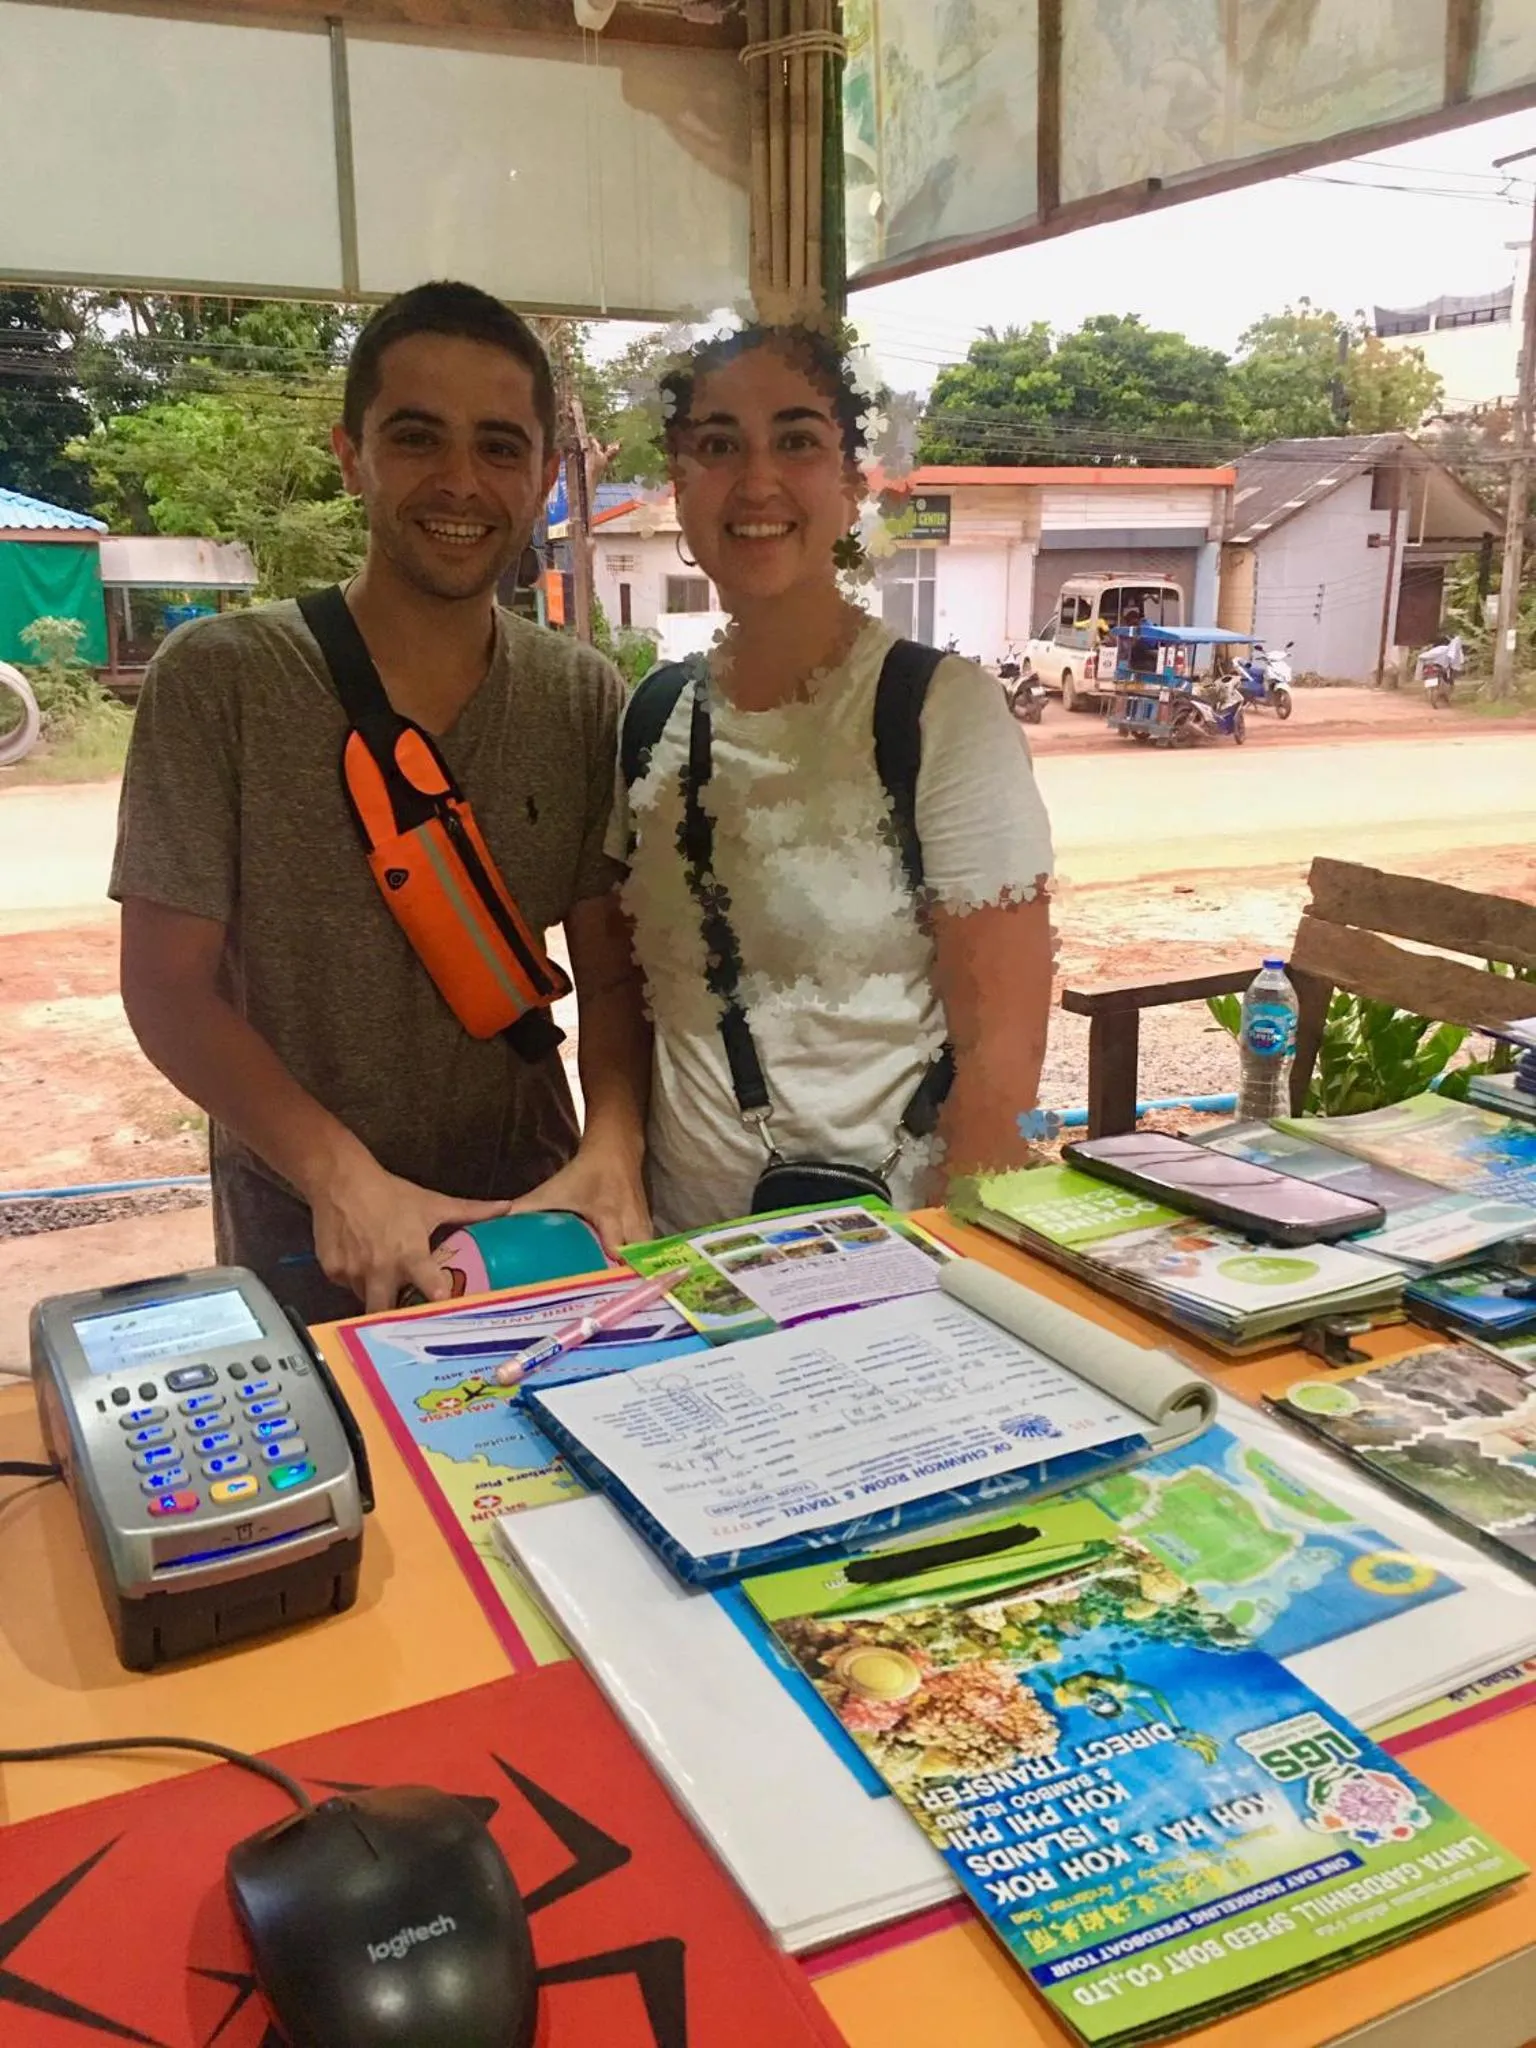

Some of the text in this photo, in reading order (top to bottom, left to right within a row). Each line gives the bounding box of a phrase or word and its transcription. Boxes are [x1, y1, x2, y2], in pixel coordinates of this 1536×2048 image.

[919, 511, 947, 527] CENTER
[1041, 1201, 1160, 1234] OOKING
[418, 1400, 495, 1423] MALAYSIA
[473, 1479, 503, 1491] Pier
[859, 1471, 910, 1494] ROOM
[779, 1495, 838, 1519] TRAVEL
[915, 1722, 1176, 1811] DIRECT TRANSFER
[1259, 1730, 1356, 1779] LGS
[934, 1767, 1112, 1829] & BAMBOO ISLAND
[946, 1780, 1132, 1852] KOH PHI PHI
[1210, 1792, 1276, 1829] KOH
[1099, 1815, 1121, 1835] 4
[1131, 1833, 1160, 1854] &
[1160, 1815, 1210, 1845] HA
[965, 1823, 1099, 1877] ISLANDS
[1059, 1843, 1132, 1882] KOH
[1417, 1835, 1490, 1873] LANTA
[984, 1867, 1058, 1906] ROK
[1290, 1861, 1423, 1923] GARDENHILL
[1049, 1855, 1351, 1978] ONE DAY SNORKELING SPEEDBOAT TOUR
[1222, 1910, 1296, 1952] SPEED
[367, 1913, 457, 1964] logitech
[1162, 1938, 1226, 1975] BOAT
[1072, 1962, 1163, 2007] CO.,LTD
